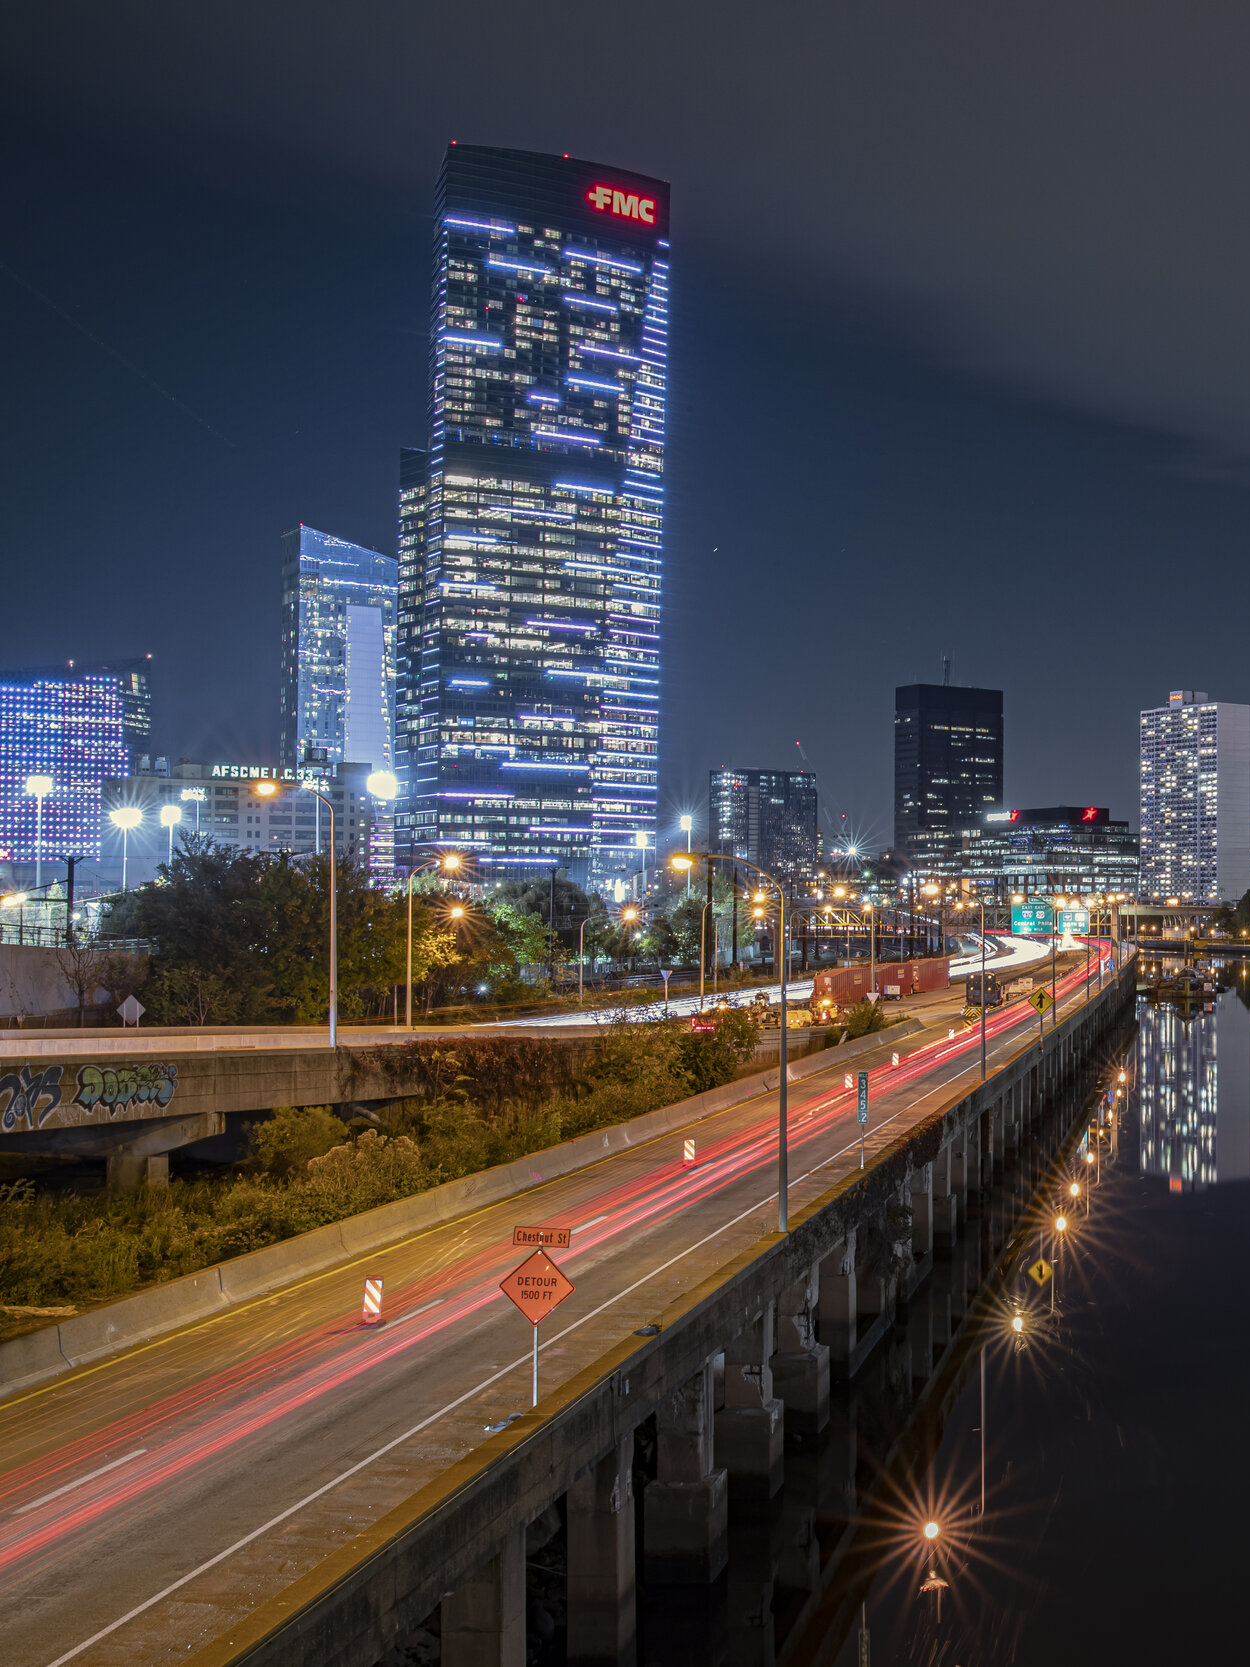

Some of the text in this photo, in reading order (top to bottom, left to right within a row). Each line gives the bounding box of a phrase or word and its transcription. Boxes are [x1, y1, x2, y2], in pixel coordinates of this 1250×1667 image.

[589, 186, 654, 223] FMC
[212, 765, 269, 779] AFSCME
[516, 1230, 566, 1244] Chestnut St
[517, 1276, 558, 1287] DETOUR
[521, 1290, 552, 1300] 1500 FT
